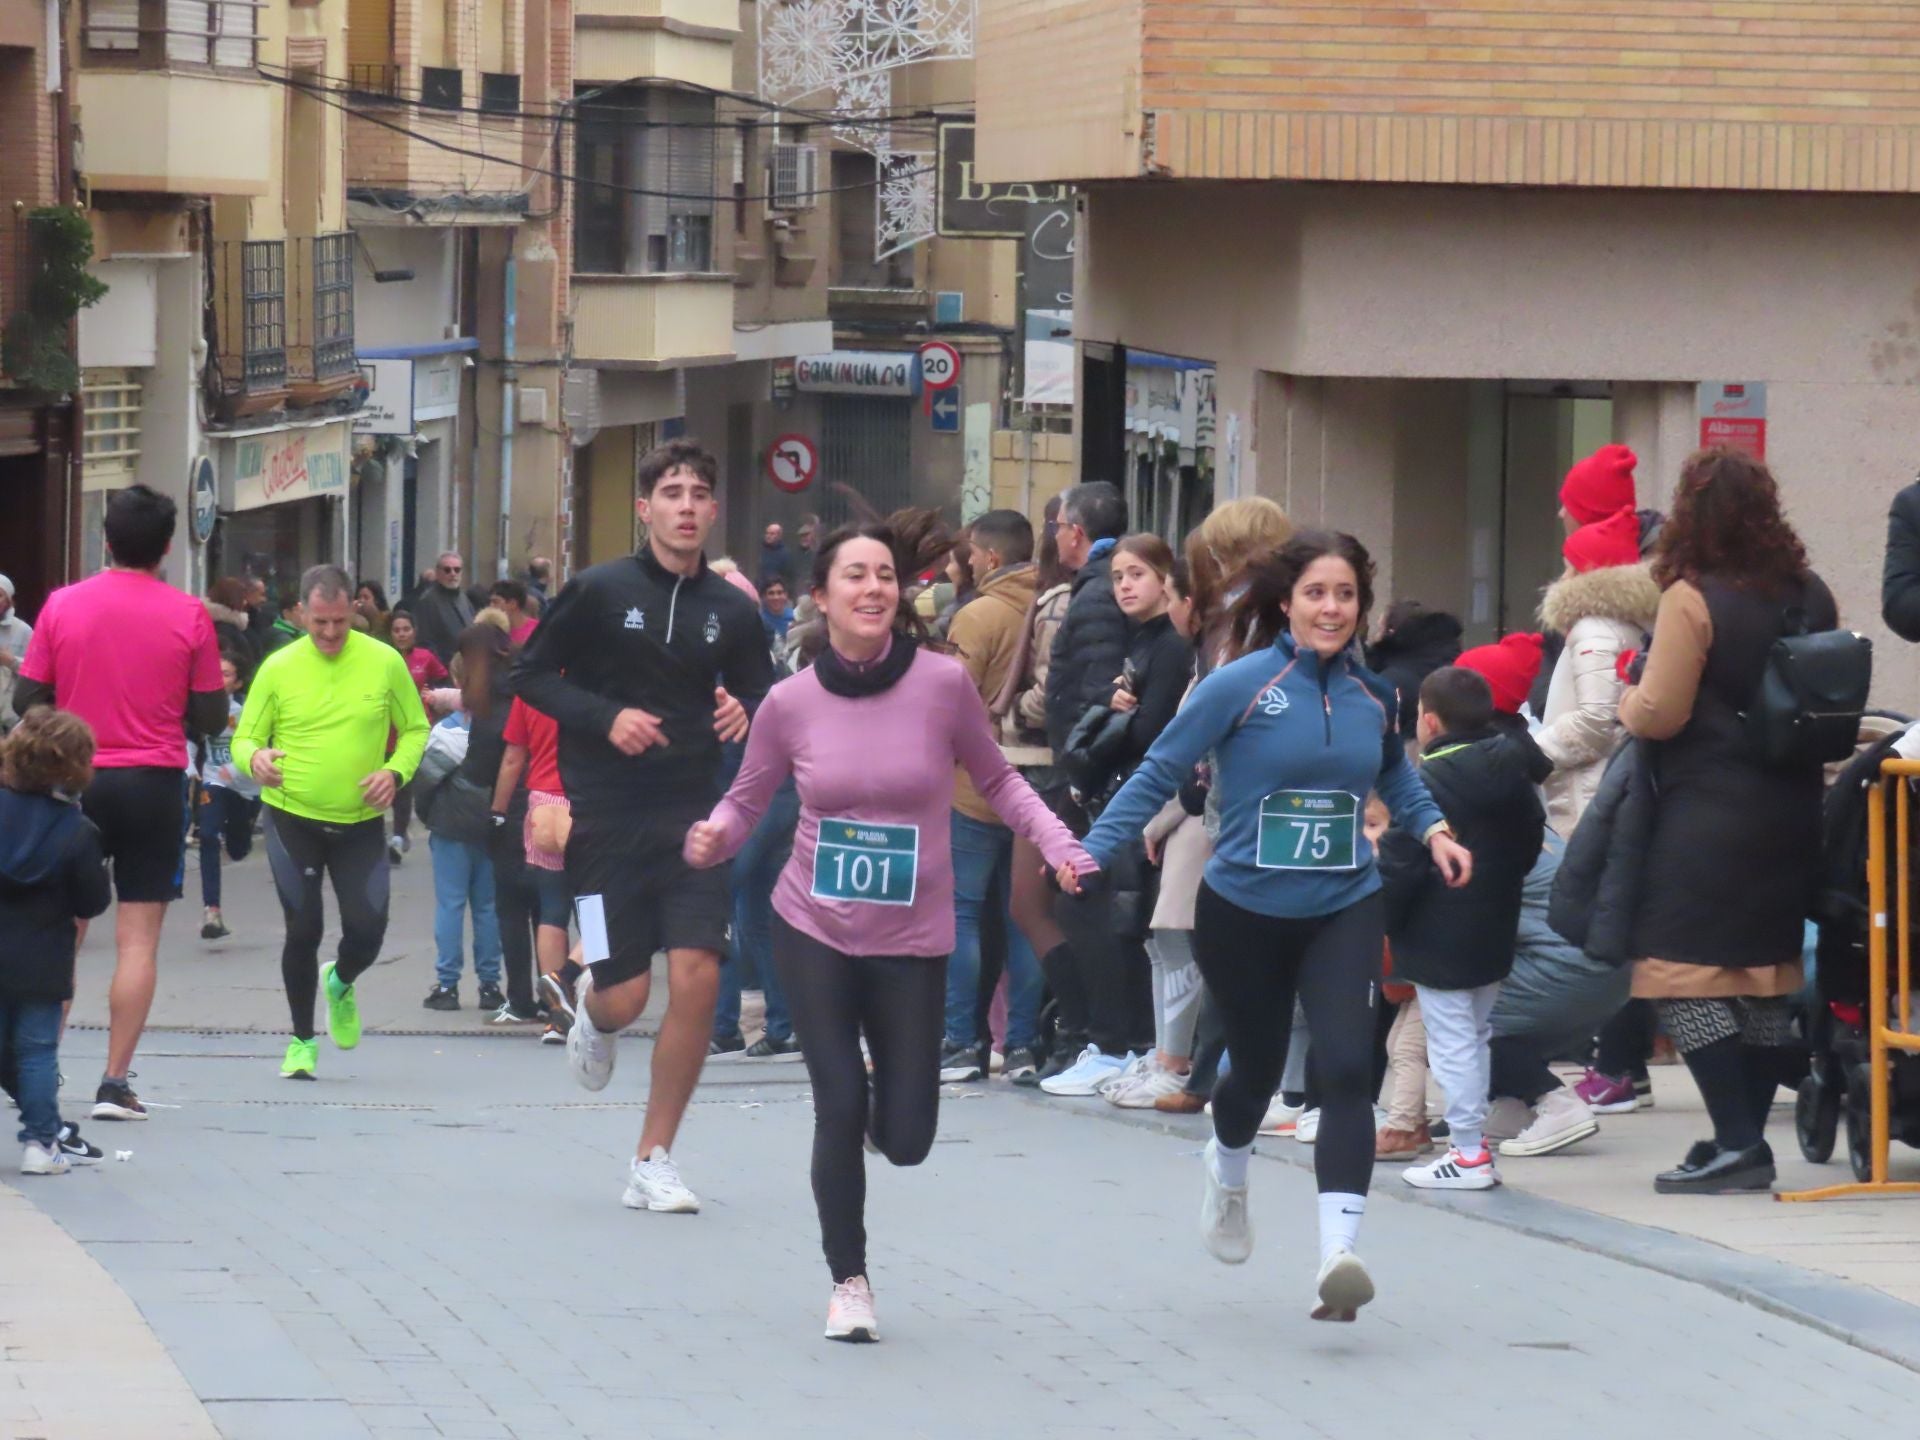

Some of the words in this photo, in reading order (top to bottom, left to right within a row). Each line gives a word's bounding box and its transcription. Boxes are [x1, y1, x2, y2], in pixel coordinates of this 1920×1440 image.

[924, 358, 949, 374] 20
[1707, 421, 1758, 434] Alarma
[1290, 821, 1331, 859] 75
[833, 852, 890, 894] 101
